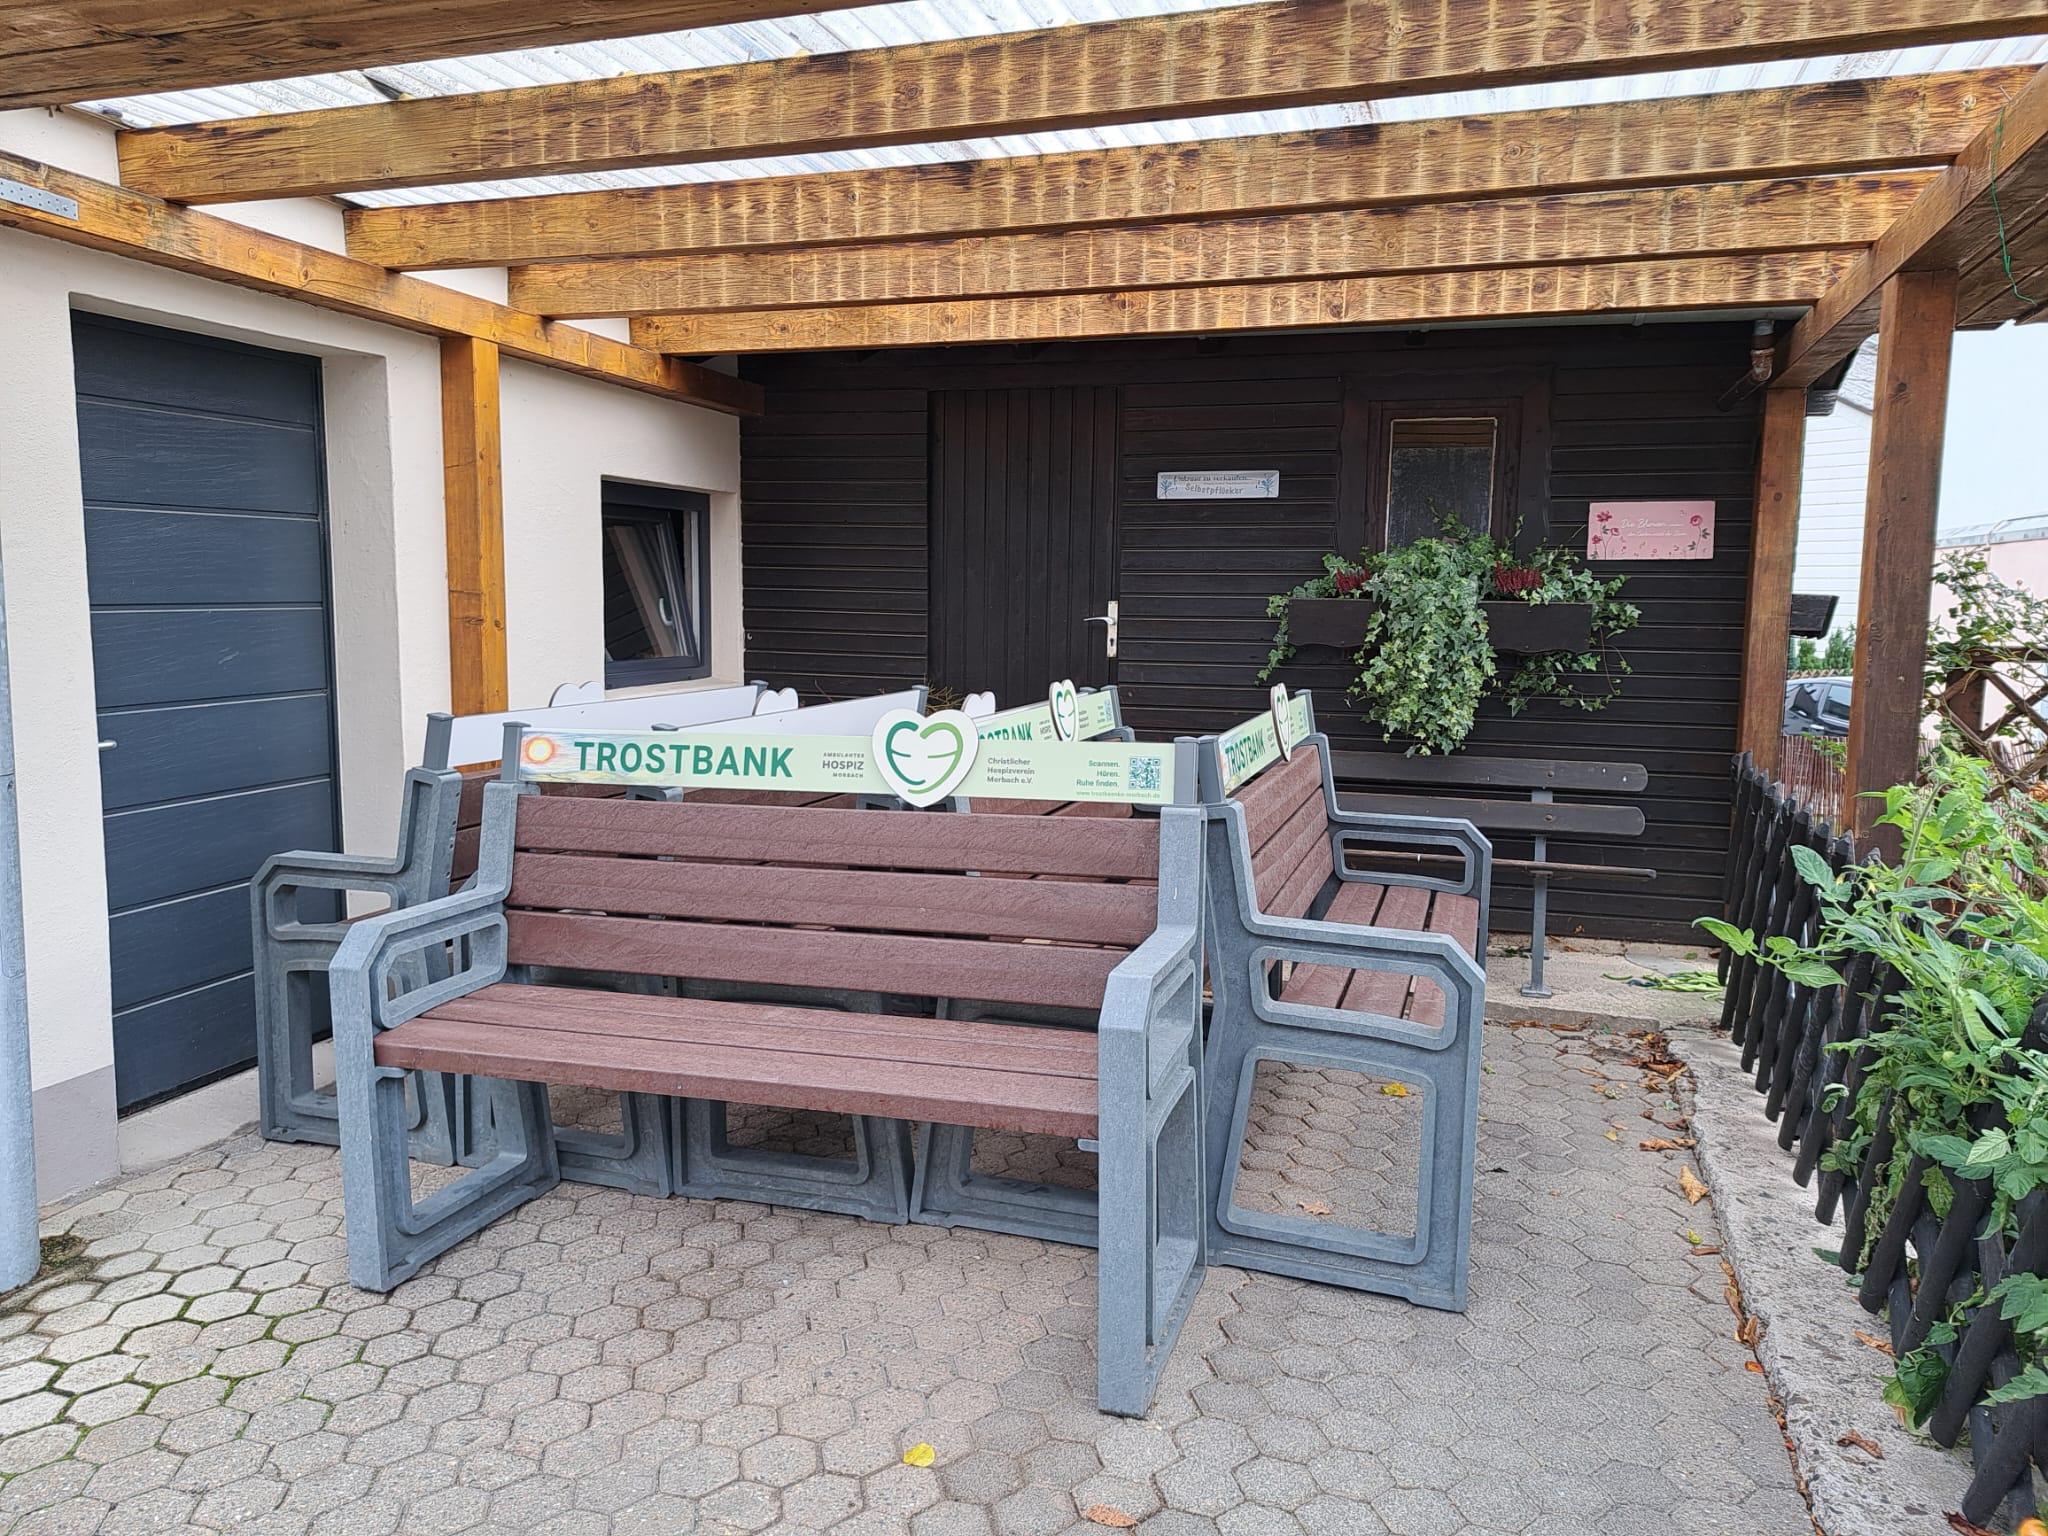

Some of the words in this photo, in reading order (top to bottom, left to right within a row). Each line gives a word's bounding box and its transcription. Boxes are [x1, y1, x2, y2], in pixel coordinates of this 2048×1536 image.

[1225, 728, 1266, 775] TROSTBANK
[574, 741, 794, 778] TROSTBANK
[987, 757, 1031, 765] Christlicher
[822, 760, 864, 770] HOSPIZ
[987, 767, 1035, 775] Hospizverein
[1097, 769, 1120, 777] Hören.
[1076, 779, 1094, 787] Ruhe
[1096, 779, 1120, 788] finden.
